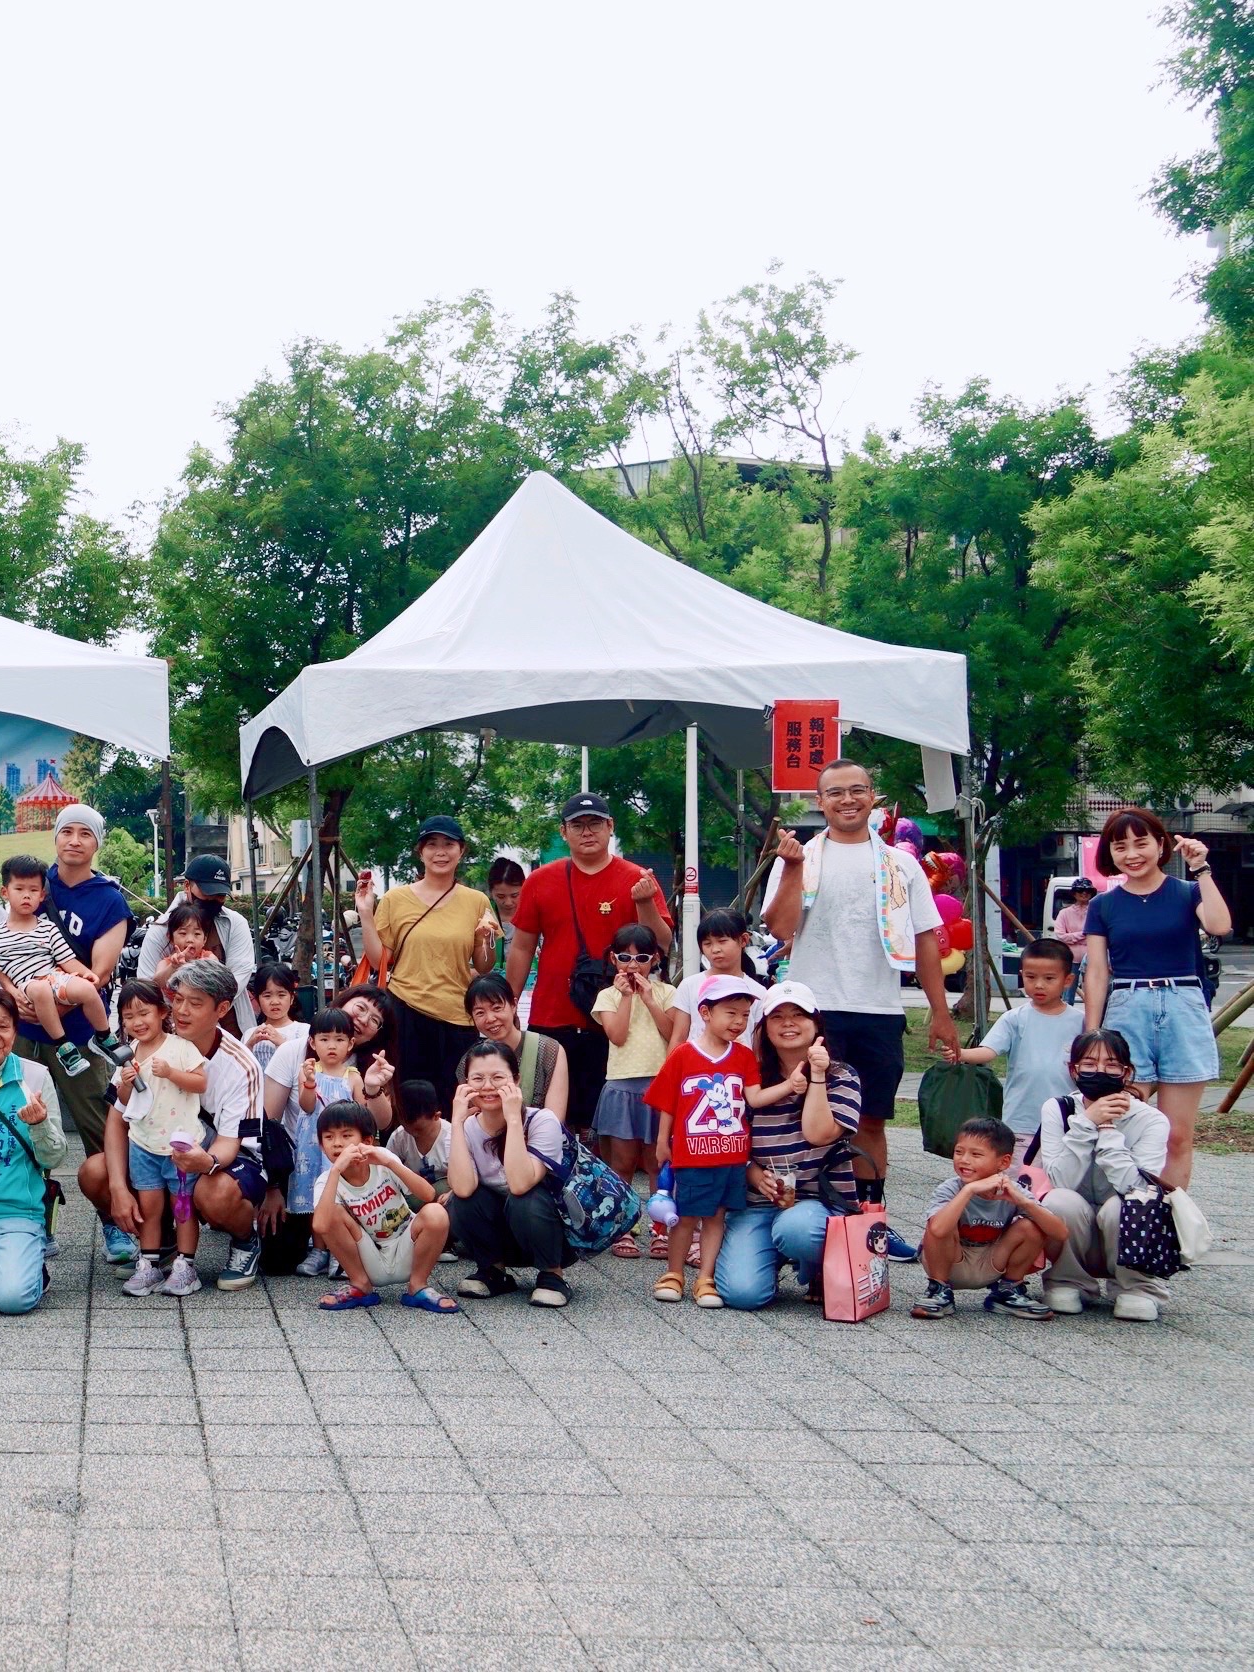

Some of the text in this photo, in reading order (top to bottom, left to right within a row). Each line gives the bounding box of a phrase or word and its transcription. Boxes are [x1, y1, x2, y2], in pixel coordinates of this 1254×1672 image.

[787, 721, 802, 769] 服務台
[3, 1104, 17, 1167] 三民德仁里
[687, 1134, 749, 1155] VARSIT
[348, 1185, 396, 1217] OMICA
[366, 1214, 378, 1227] 47
